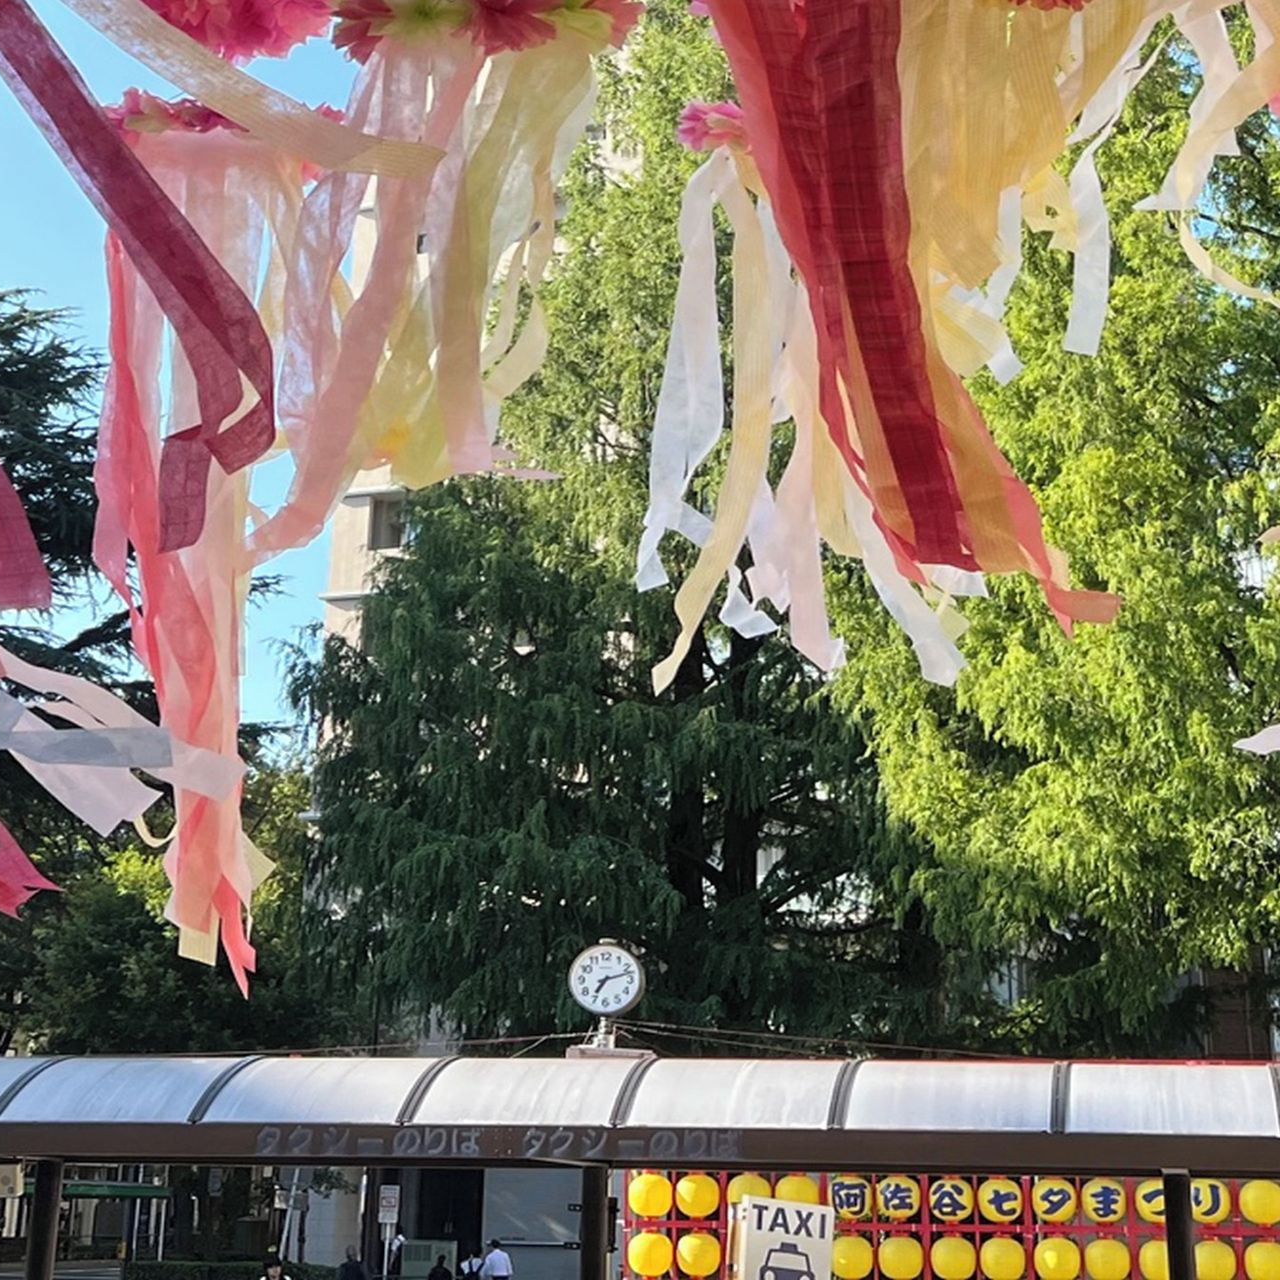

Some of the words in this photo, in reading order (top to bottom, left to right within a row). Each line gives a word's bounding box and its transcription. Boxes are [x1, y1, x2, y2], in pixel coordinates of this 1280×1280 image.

[256, 1126, 484, 1155] タクシーのりば
[522, 1127, 742, 1157] タクシーのりば
[831, 1181, 1220, 1218] 阿佐谷七夕まつり
[751, 1203, 827, 1240] TAXI
